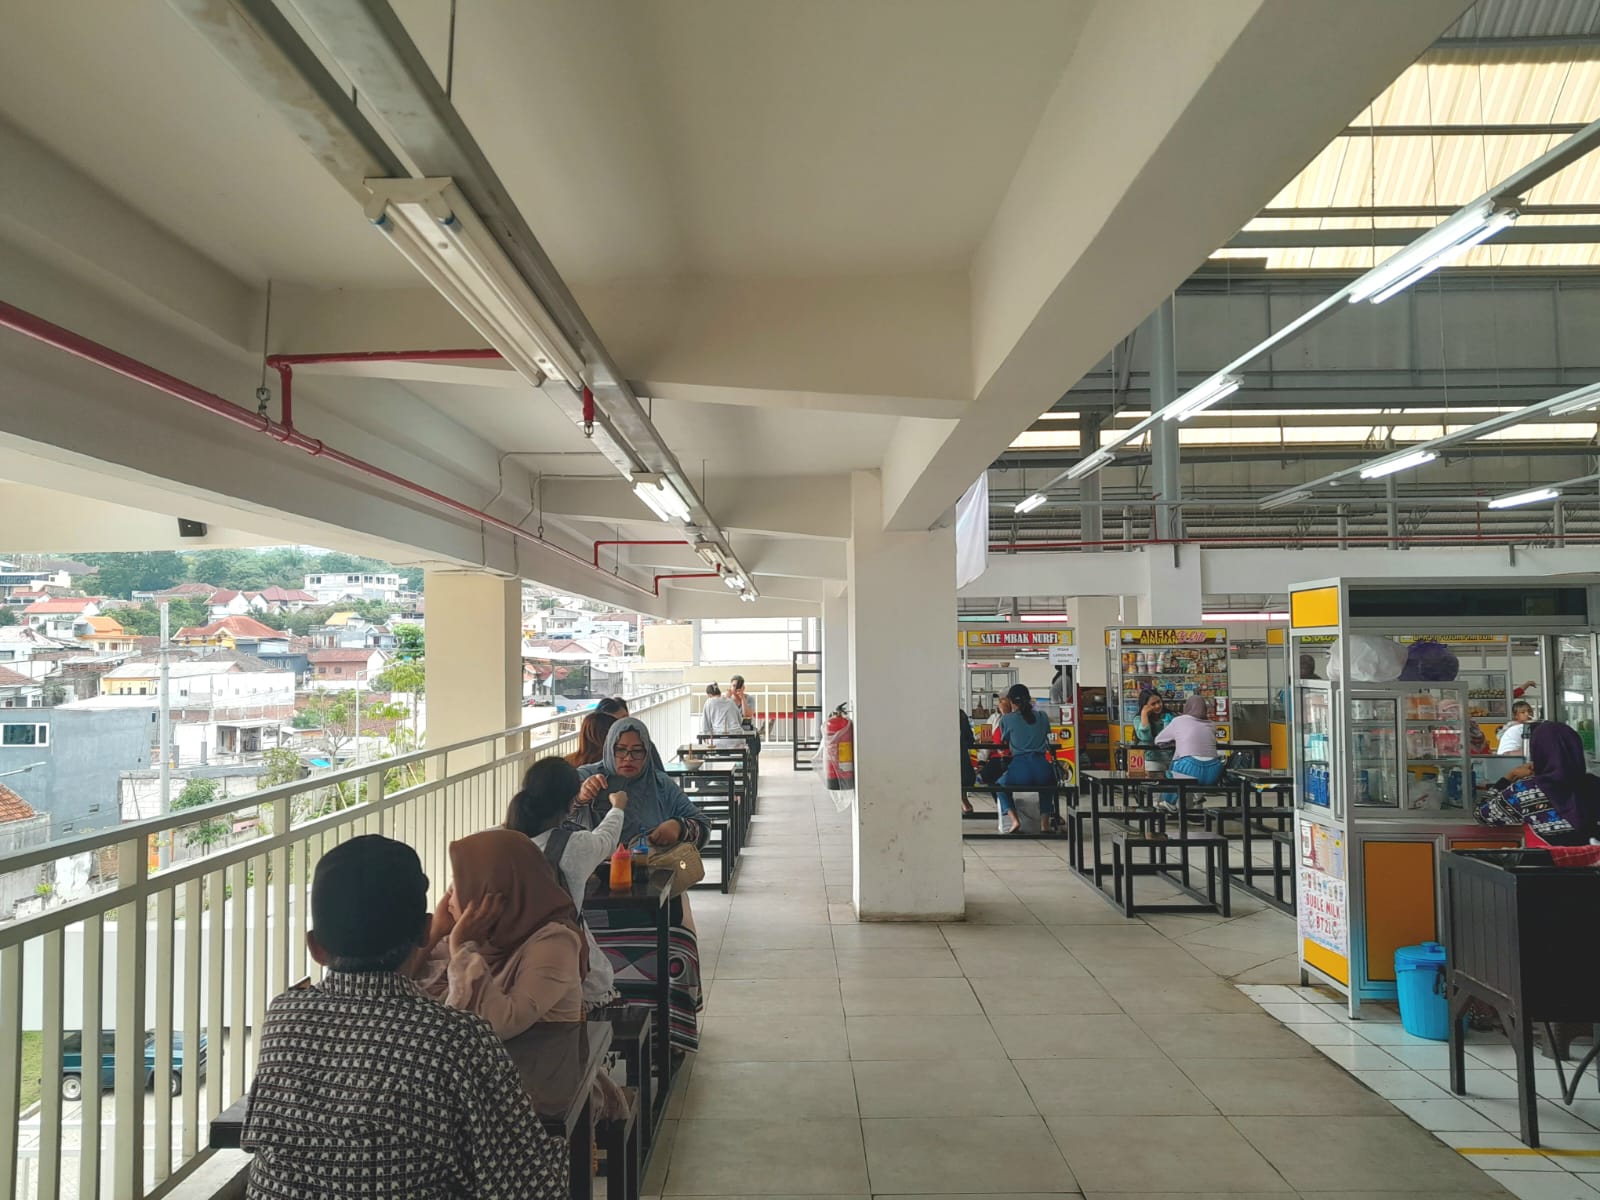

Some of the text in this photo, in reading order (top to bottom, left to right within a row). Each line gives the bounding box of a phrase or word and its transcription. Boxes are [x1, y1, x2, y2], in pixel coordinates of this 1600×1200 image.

[981, 633, 1058, 644] SATE MBAK NURFI
[1140, 629, 1178, 639] ANEKA
[1130, 755, 1144, 768] 20
